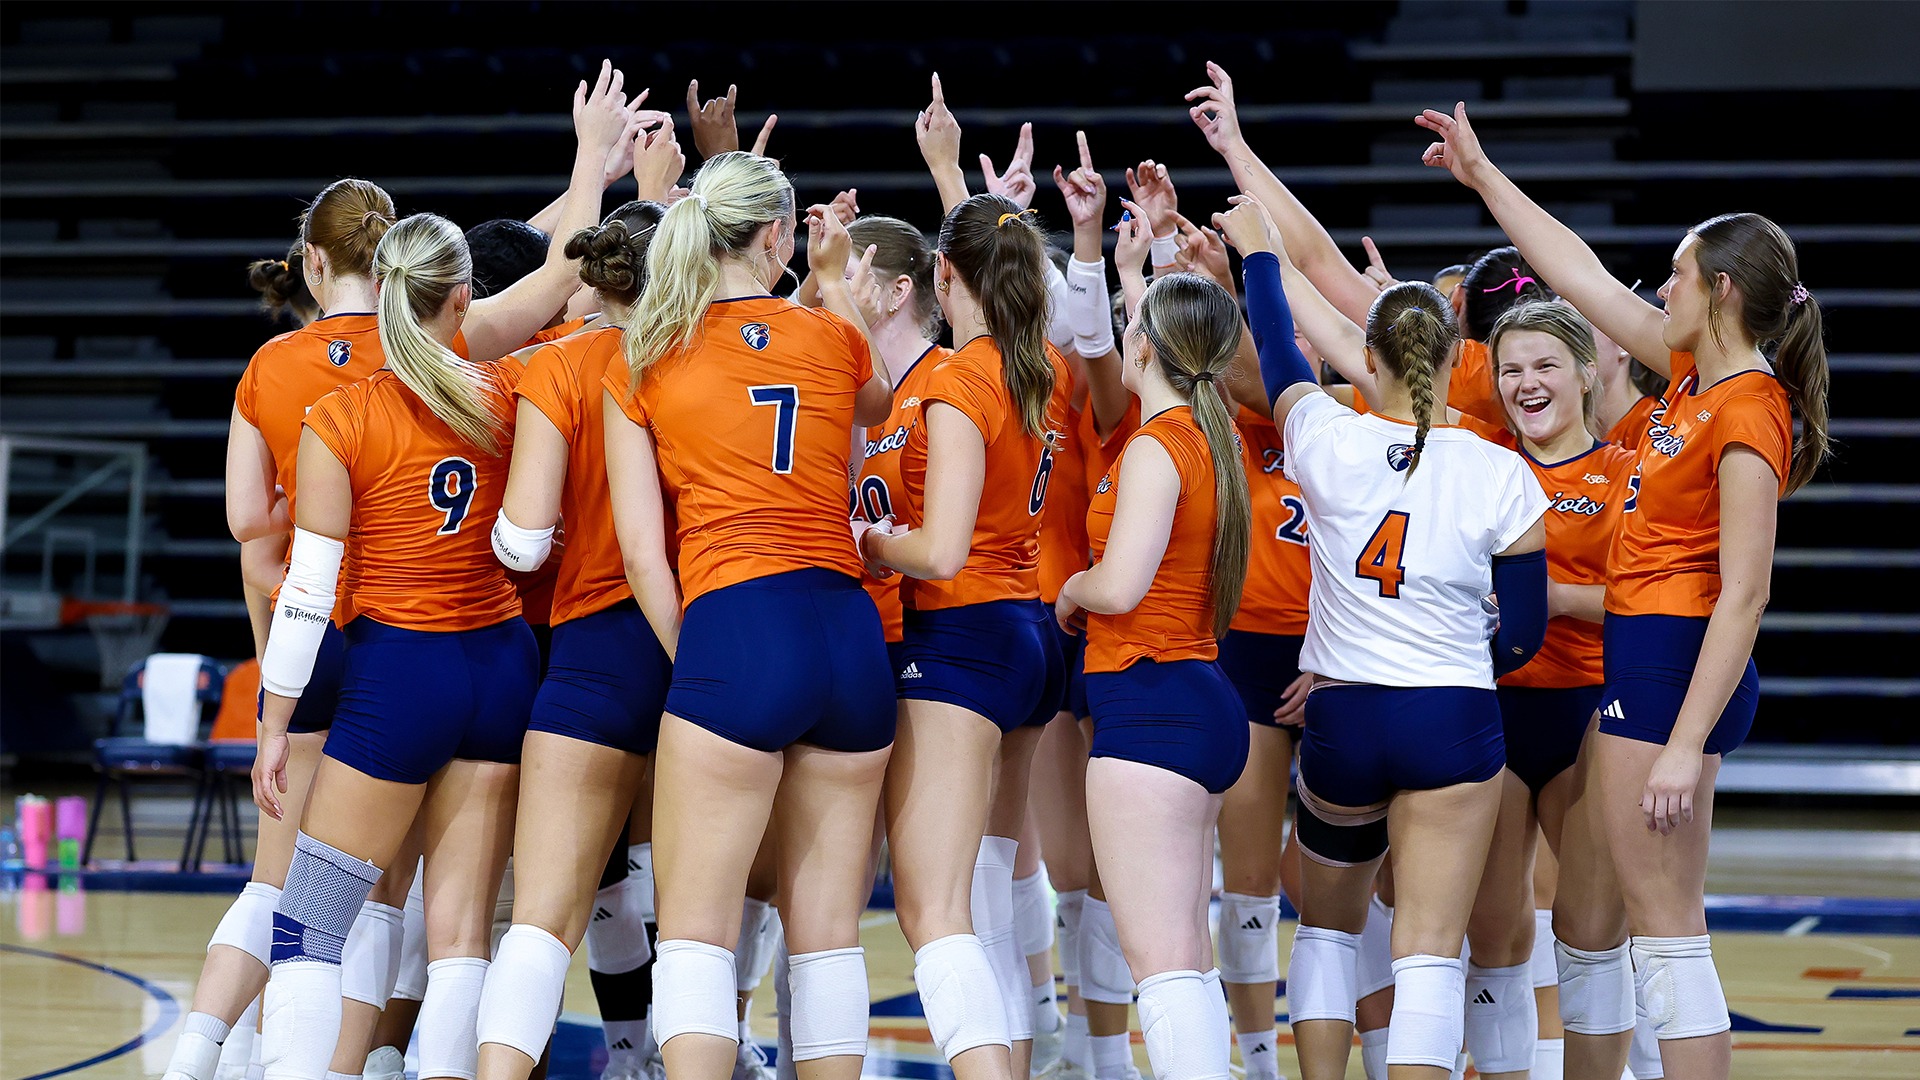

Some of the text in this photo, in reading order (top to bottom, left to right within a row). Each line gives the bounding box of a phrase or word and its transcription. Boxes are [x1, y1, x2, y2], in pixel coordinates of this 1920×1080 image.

[746, 384, 799, 474] 7
[428, 456, 478, 536] 9
[1028, 430, 1054, 516] 6
[1355, 510, 1410, 599] 4
[285, 605, 328, 626] Tandem
